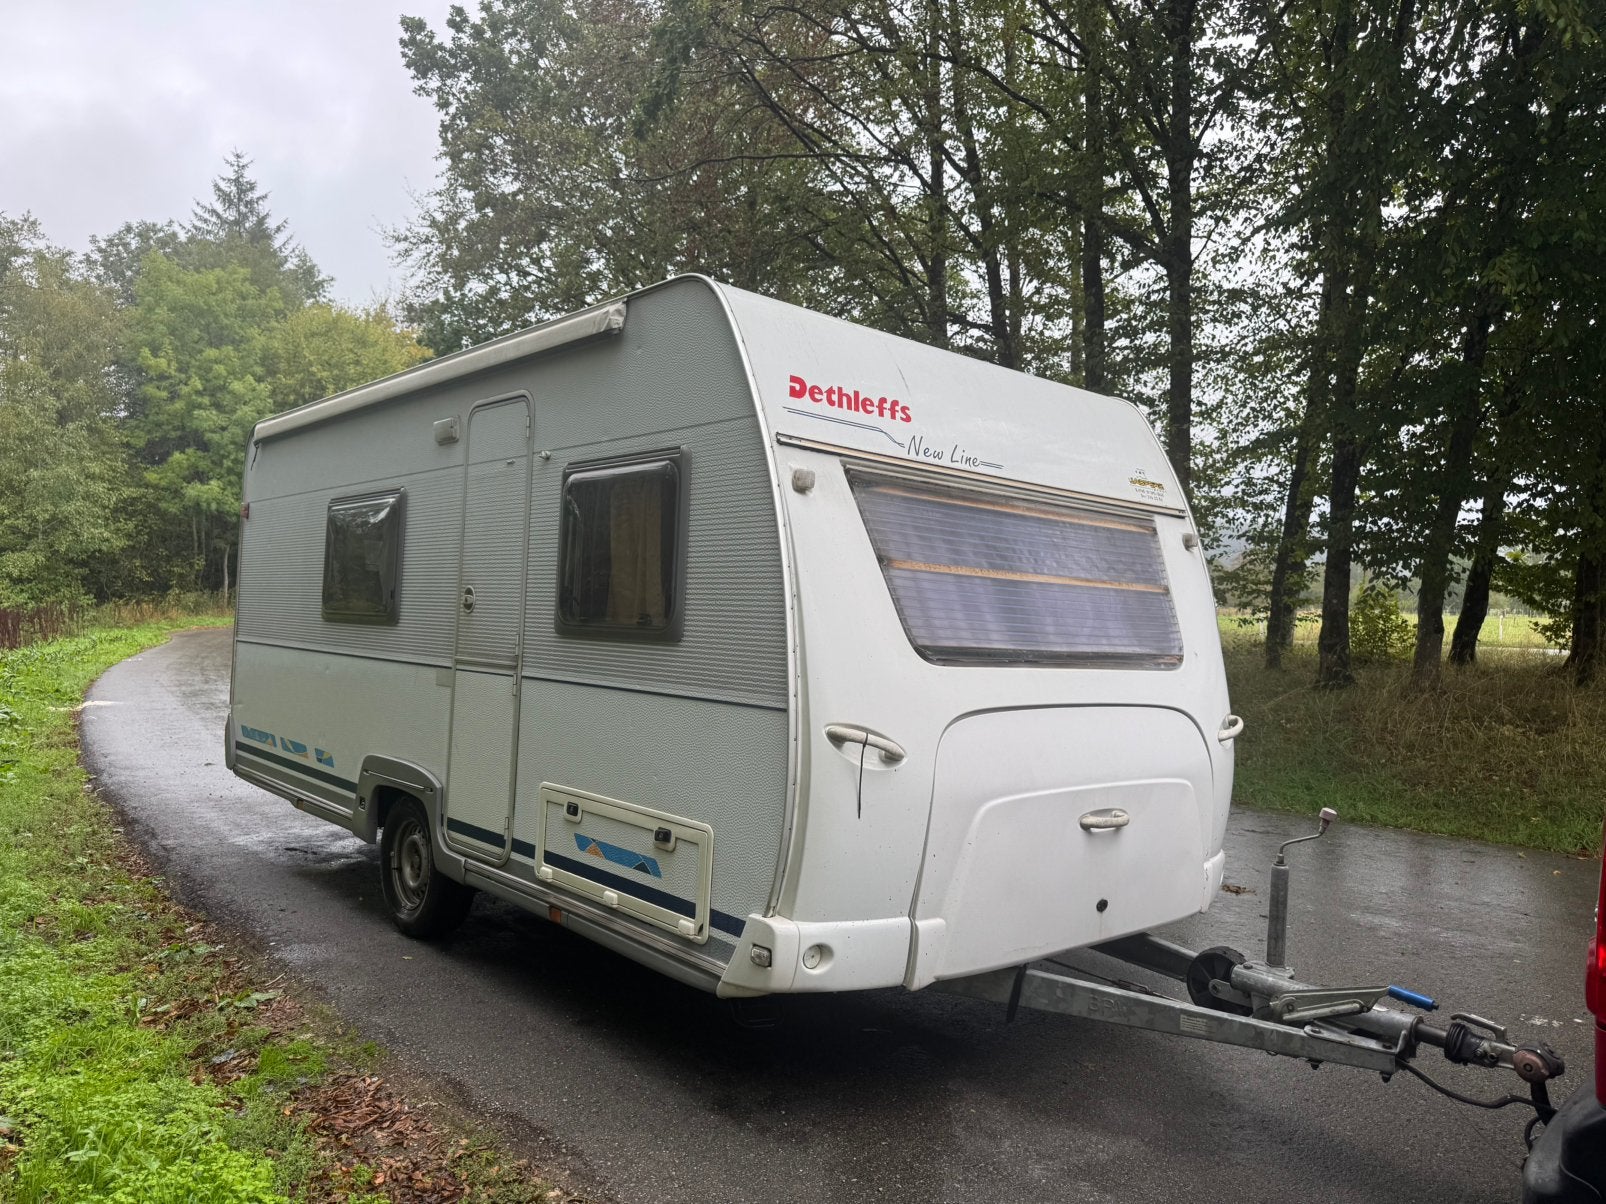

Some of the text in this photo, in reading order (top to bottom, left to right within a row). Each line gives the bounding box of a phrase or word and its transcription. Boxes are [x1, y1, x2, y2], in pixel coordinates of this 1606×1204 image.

[789, 375, 912, 423] Dethleffs
[907, 435, 981, 468] New Line
